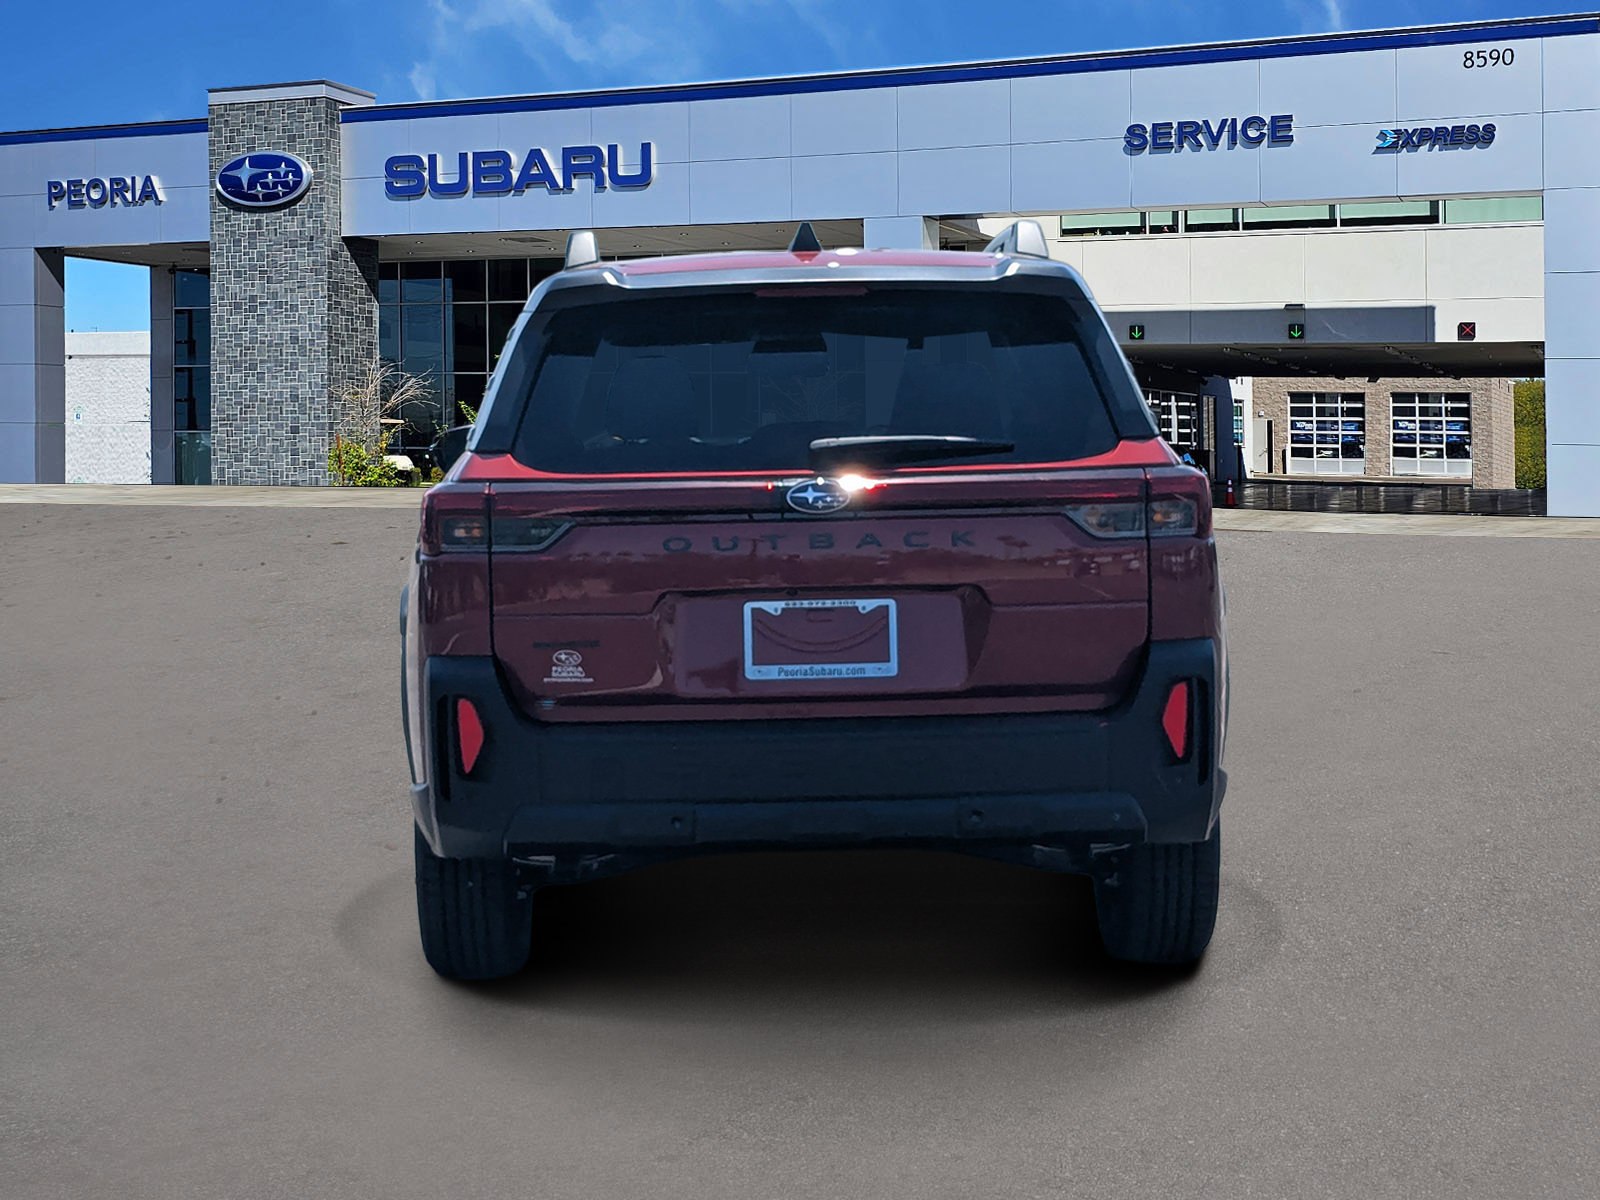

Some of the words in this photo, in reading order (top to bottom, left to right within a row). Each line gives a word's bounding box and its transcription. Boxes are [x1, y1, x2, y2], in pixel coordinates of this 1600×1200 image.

[1463, 48, 1515, 69] 8590
[1125, 114, 1294, 151] SERVICE
[1376, 122, 1496, 150] EXPRESS
[384, 141, 653, 197] SUBARU
[47, 175, 161, 208] PEORIA
[662, 529, 977, 553] OUTBACK
[777, 665, 867, 678] PeoriaSubaru.com
